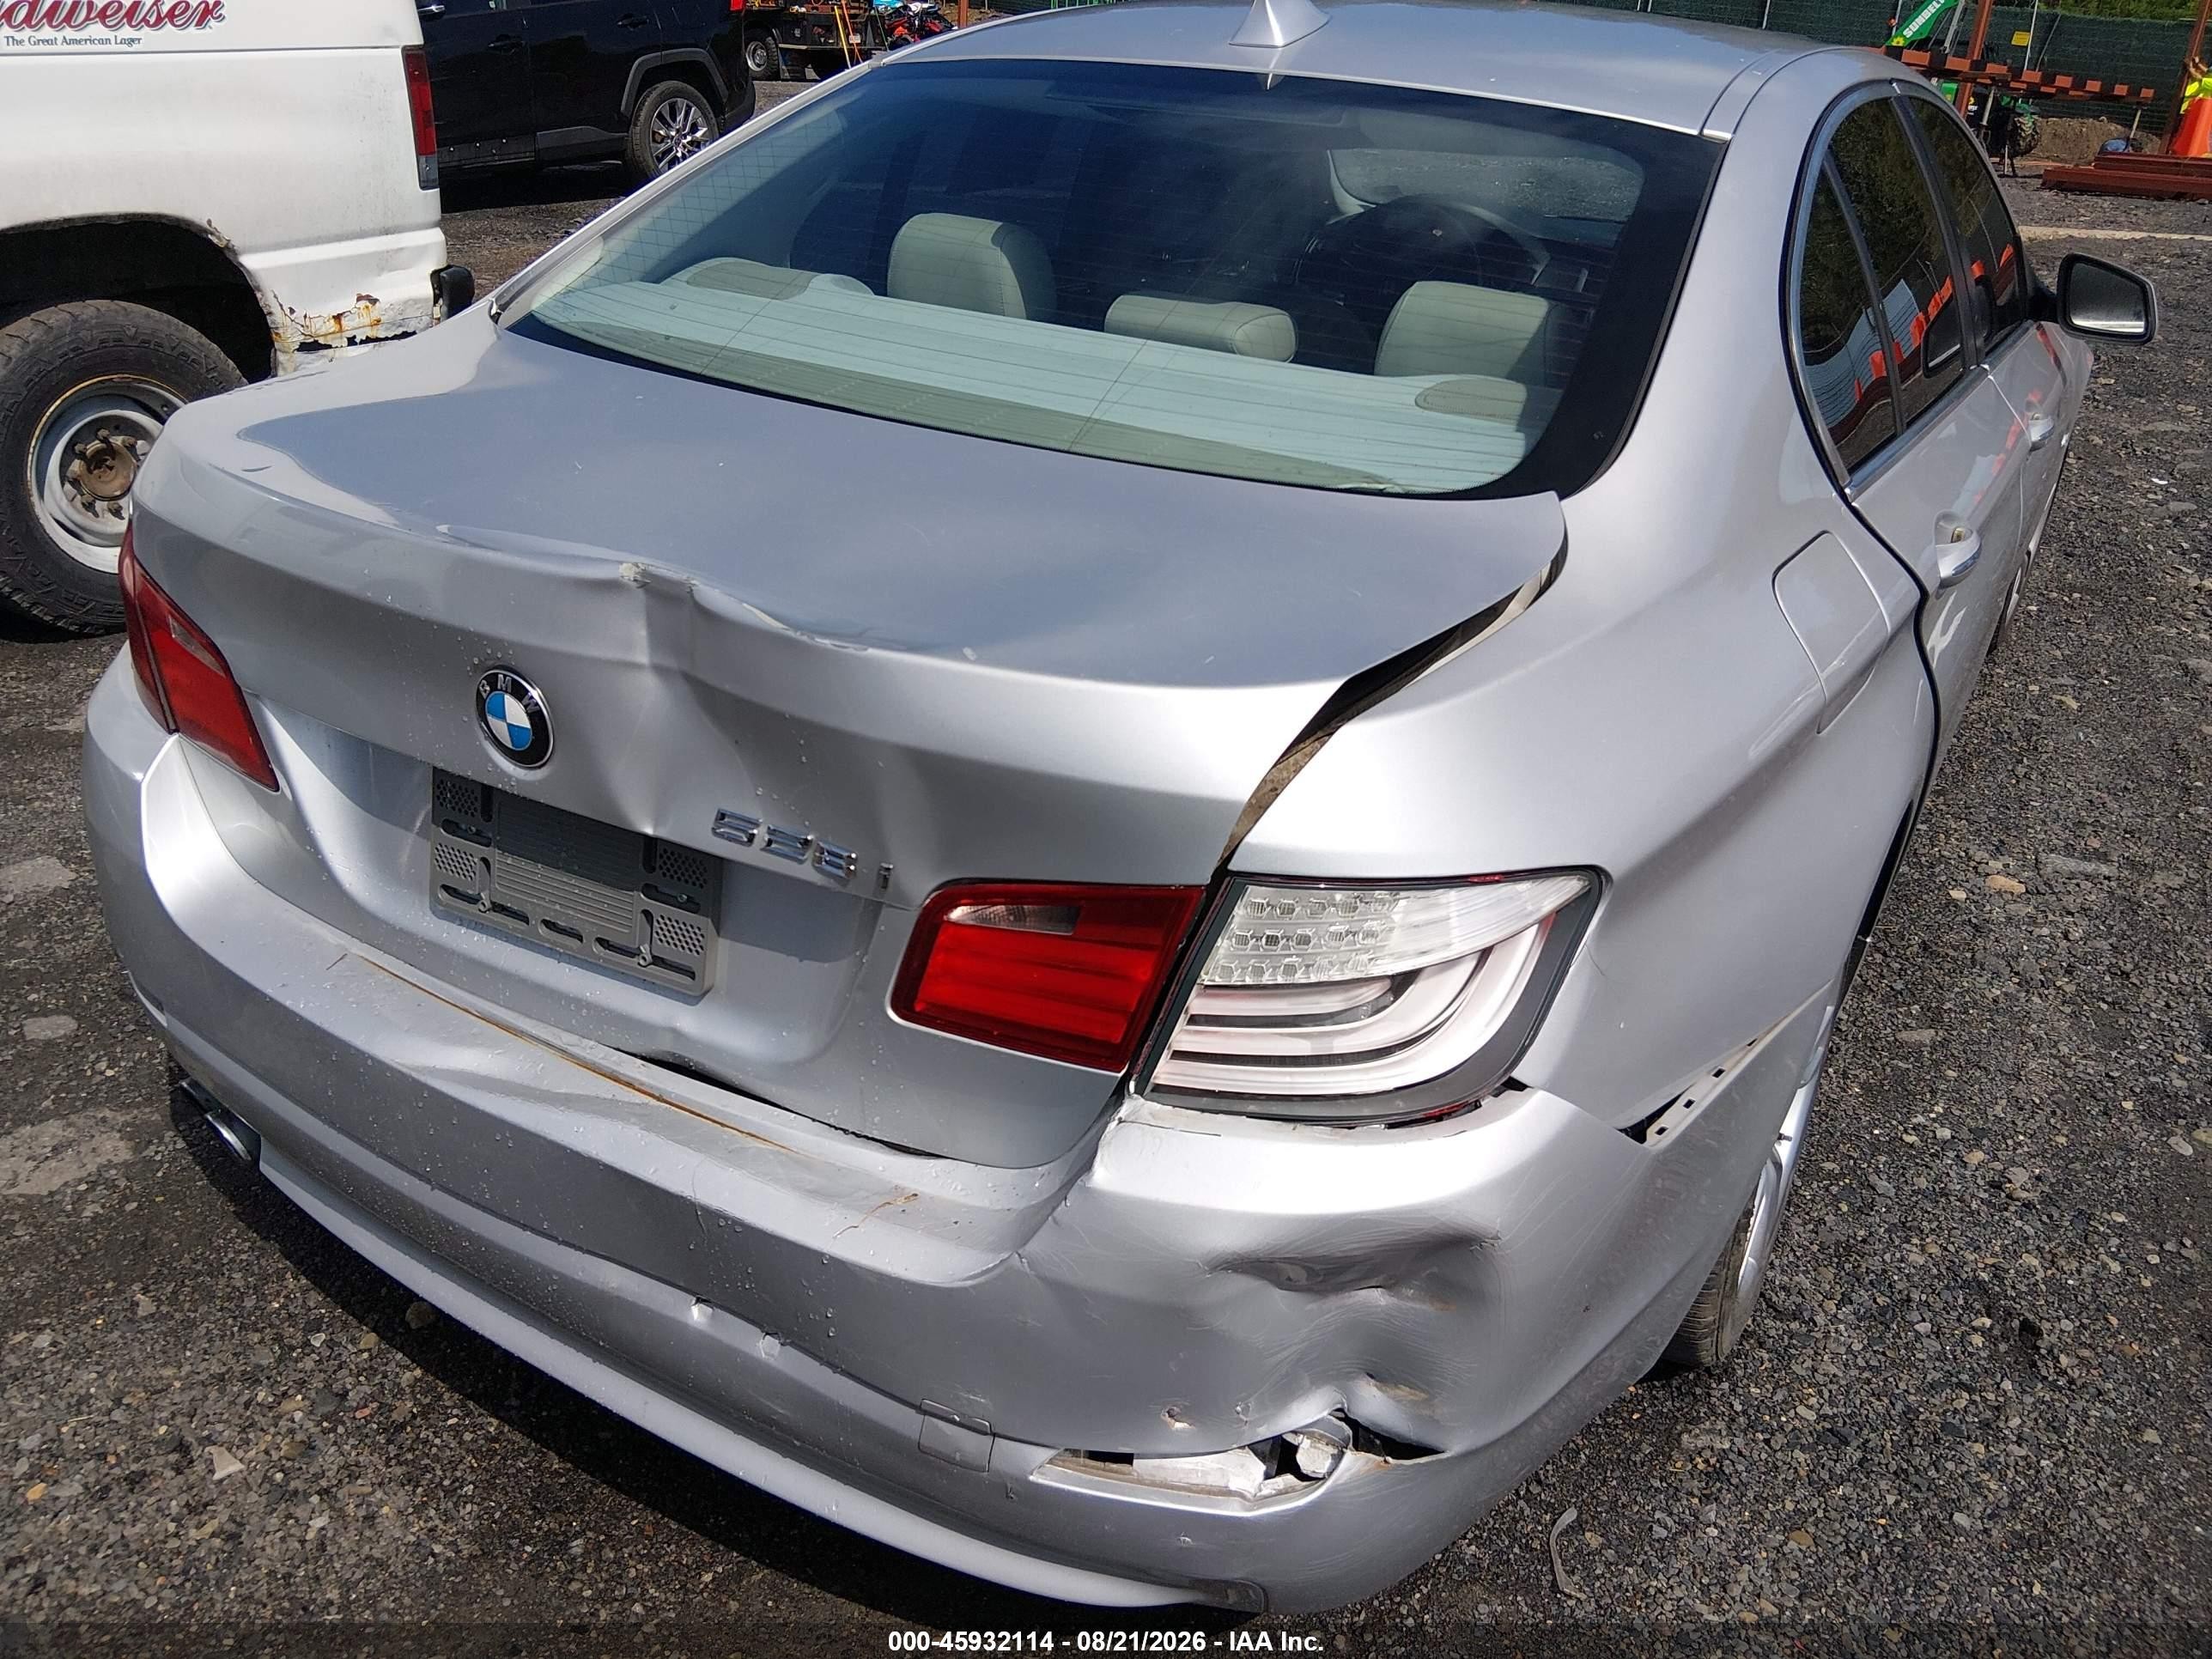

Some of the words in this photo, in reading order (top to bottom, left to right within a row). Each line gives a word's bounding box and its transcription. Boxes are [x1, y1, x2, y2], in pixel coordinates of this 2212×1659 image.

[4, 35, 25, 46] The
[28, 35, 58, 46] Great
[61, 34, 112, 46] American
[114, 34, 143, 47] Lager
[479, 673, 540, 714] BMW
